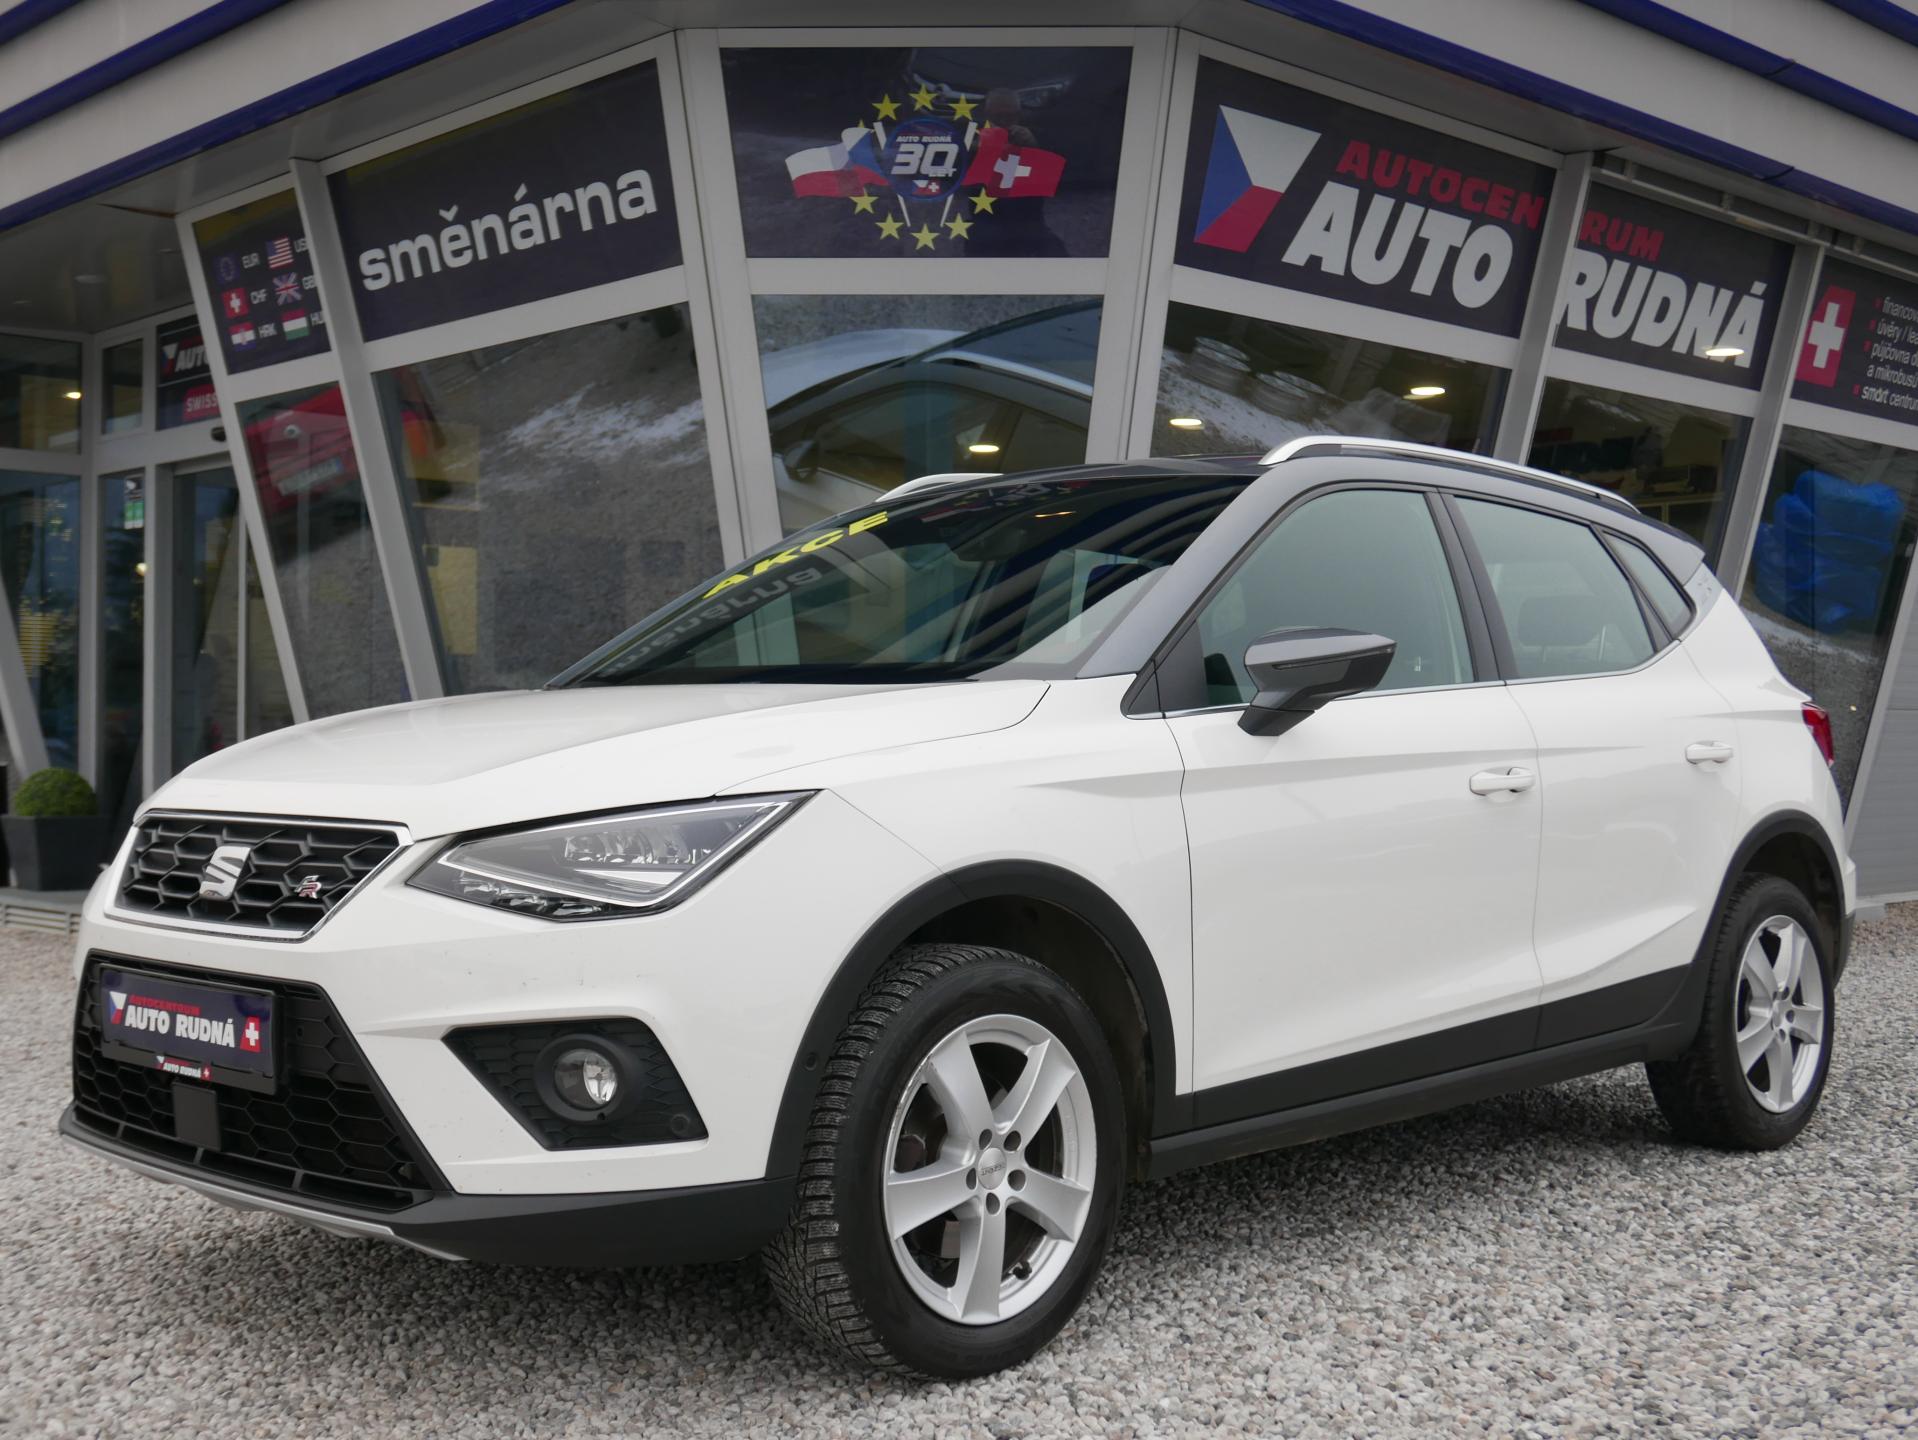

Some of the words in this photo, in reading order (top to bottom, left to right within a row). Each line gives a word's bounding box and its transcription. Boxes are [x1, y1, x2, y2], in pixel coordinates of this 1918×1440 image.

[891, 143, 959, 175] 30
[1336, 139, 1545, 230] AUTOCEN
[358, 168, 658, 292] směnárna
[1281, 180, 1514, 309] AUTO
[1578, 209, 1665, 263] RUM
[242, 252, 260, 269] EUR
[250, 288, 267, 305] CHF
[1556, 247, 1768, 369] RUDNÁ
[1866, 364, 1875, 378] a
[702, 511, 889, 600] AKCE
[124, 1005, 171, 1035] AUTO
[175, 1018, 236, 1048] RUDNÁ
